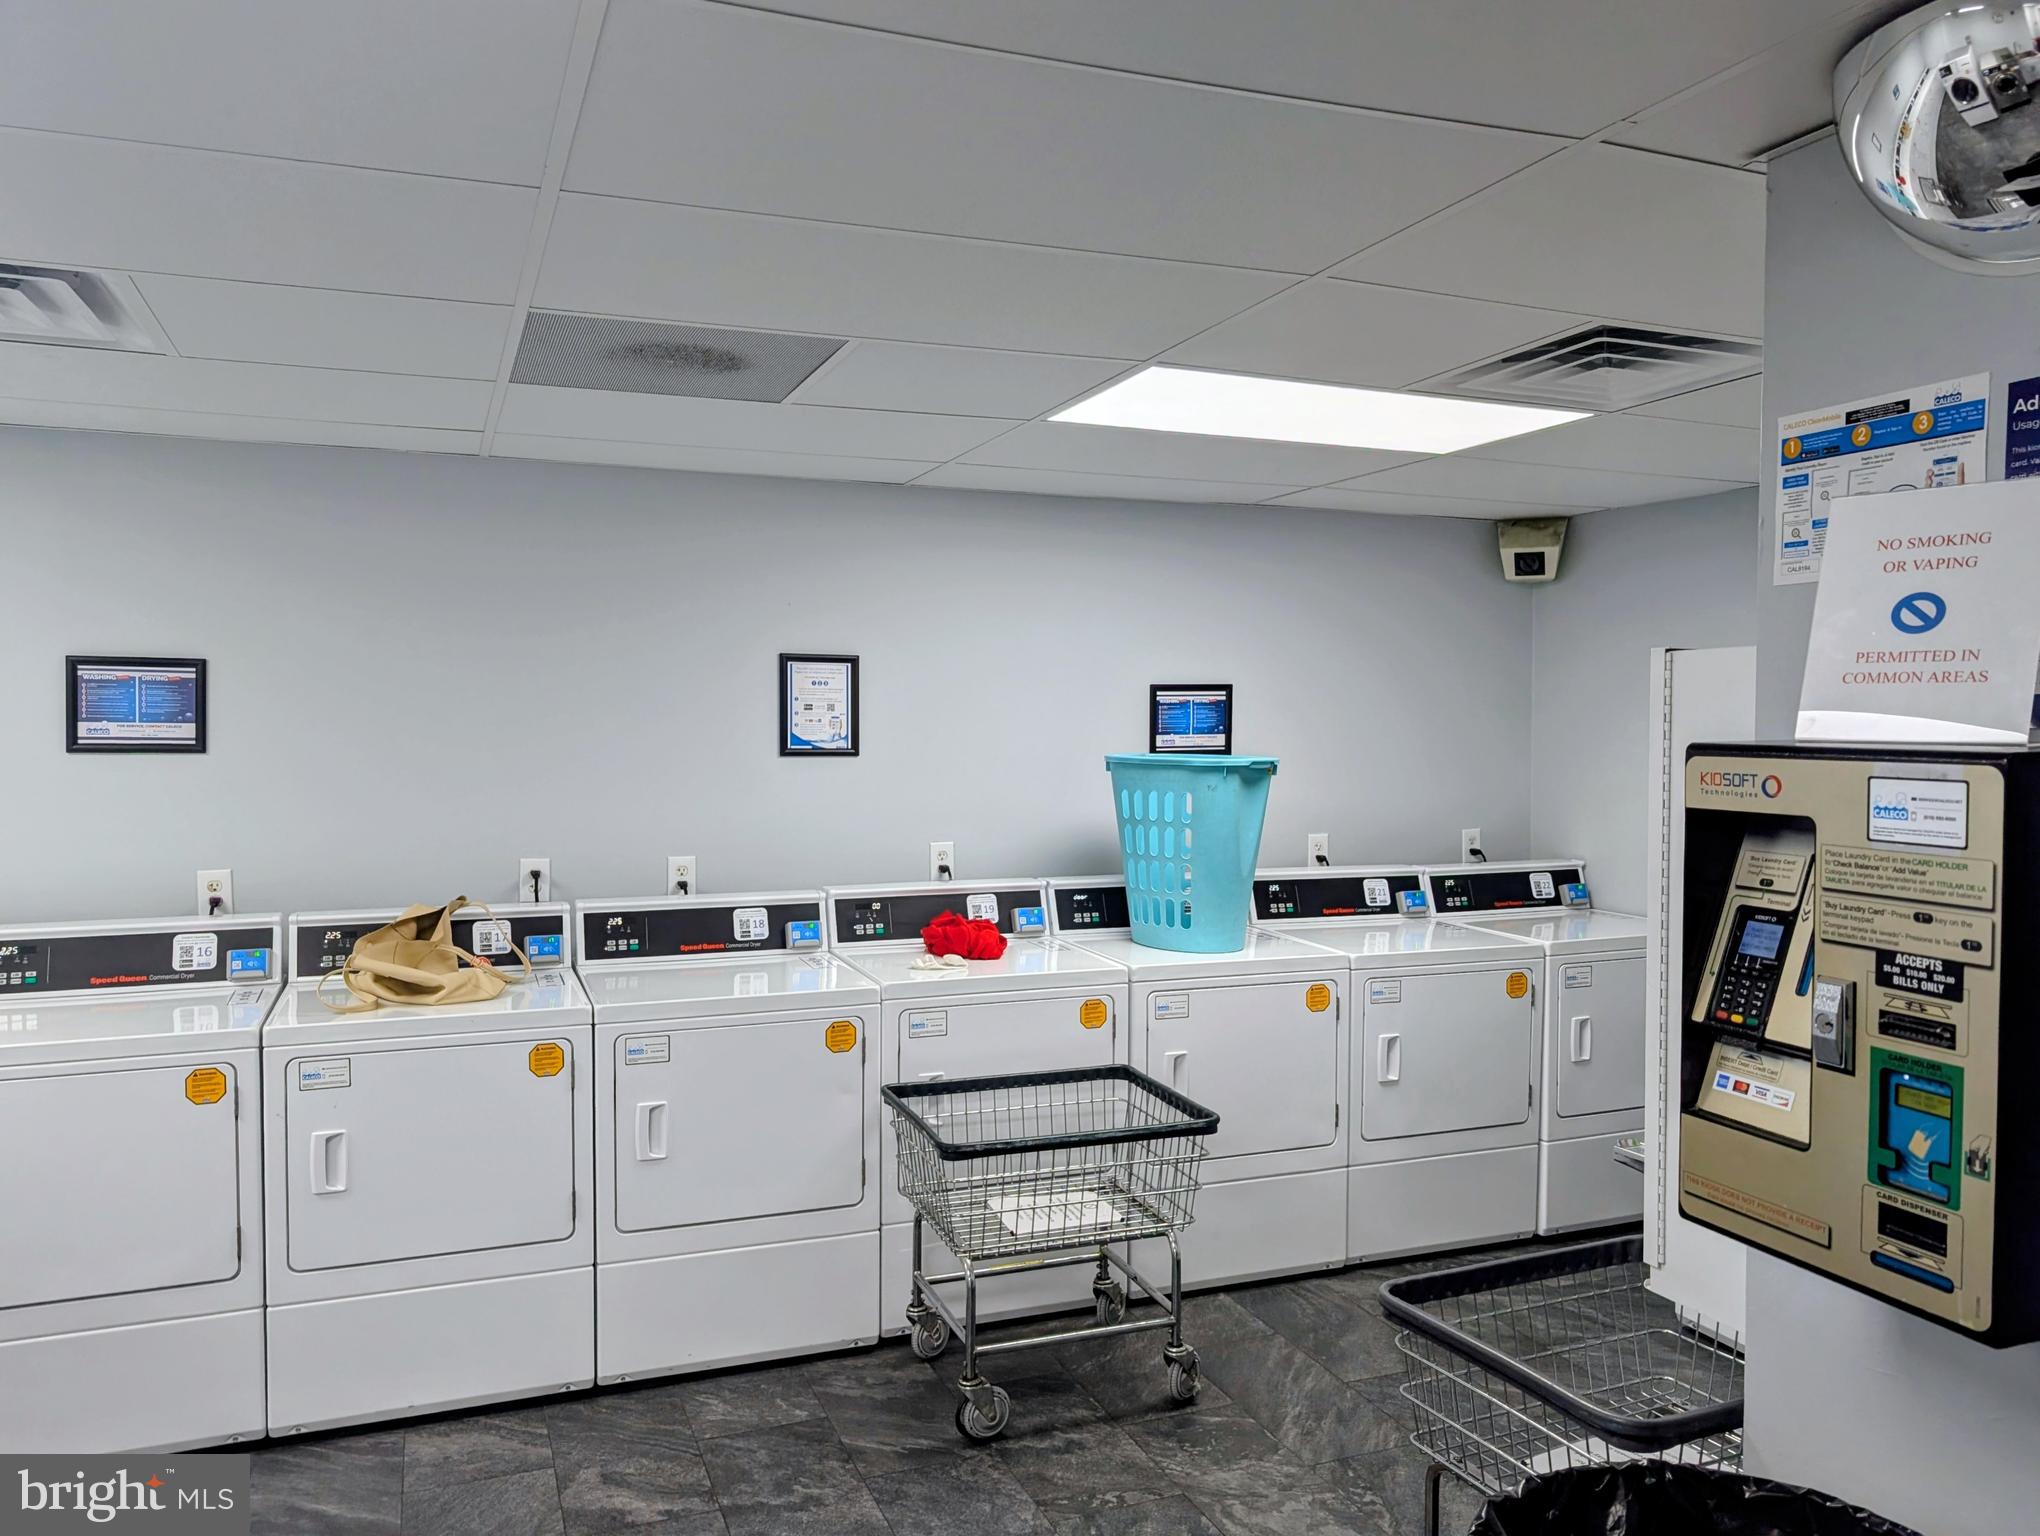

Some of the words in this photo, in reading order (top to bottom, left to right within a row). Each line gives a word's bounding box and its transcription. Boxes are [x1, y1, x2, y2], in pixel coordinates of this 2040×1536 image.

[1919, 415, 1928, 429] 3
[1857, 428, 1866, 441] 2
[1790, 441, 1795, 453] 1
[1877, 538, 1903, 551] NO
[1906, 531, 1992, 550] SMOKING
[1883, 560, 1907, 573] OR
[1913, 555, 1978, 571] VAPING
[1855, 649, 1956, 664] PERMITTED
[1962, 648, 1982, 661] IN
[82, 673, 117, 681] WASHING
[1842, 671, 1923, 684] COMMON
[1927, 669, 1990, 683] AREAS
[1700, 771, 1758, 788] KIOSOFT
[1700, 788, 1758, 798] Technologies
[1874, 807, 1907, 820] CALECO
[1825, 849, 1843, 859] Place
[1844, 851, 1871, 861] Laundry
[1873, 854, 1890, 863] Card
[1912, 858, 1934, 868] CARD
[1935, 861, 1969, 871] HOLDER
[1377, 888, 1387, 897] 21
[1936, 880, 1965, 890] TITULAR
[1966, 883, 1976, 892] DE
[1978, 884, 1987, 893] LA
[984, 904, 995, 914] 19
[1839, 903, 1866, 914] Laundry
[753, 919, 765, 929] 18
[325, 931, 342, 939] 225
[196, 946, 213, 957] 16
[1895, 953, 1943, 972] ACCEPTS
[90, 976, 118, 985] Speed
[119, 975, 147, 983] Queen
[149, 973, 179, 981] Commercial
[180, 972, 195, 980] Dryer
[1883, 964, 1901, 974] $5.00
[1906, 968, 1928, 980] $10.00
[1933, 973, 1955, 985] $20.00
[1893, 975, 1919, 989] BILLS
[1920, 981, 1944, 994] ONLY
[1888, 1053, 1909, 1065] CARD
[1910, 1057, 1942, 1072] HOLDER
[1876, 1191, 1899, 1204] CARD
[1901, 1200, 1948, 1221] DISPENSER
